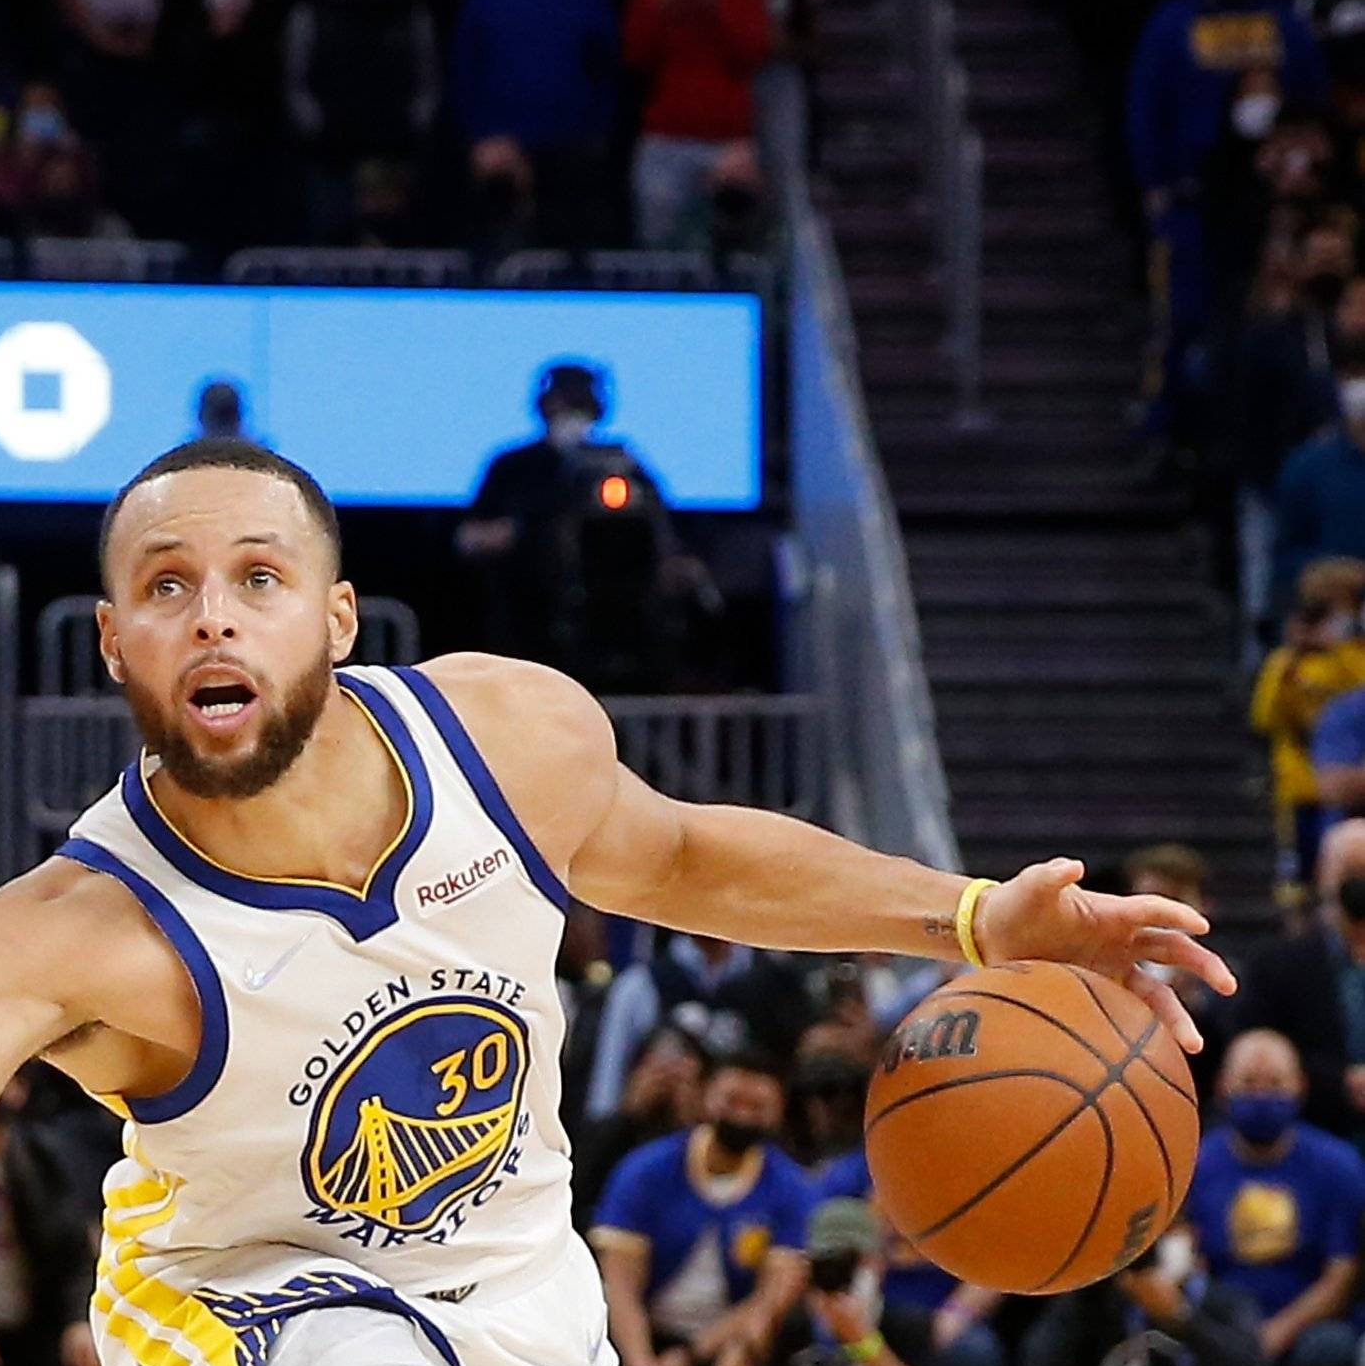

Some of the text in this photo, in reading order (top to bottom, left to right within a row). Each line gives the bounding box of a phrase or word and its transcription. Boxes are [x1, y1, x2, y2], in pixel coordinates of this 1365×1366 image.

[416, 847, 510, 908] Rakuten
[288, 967, 527, 1108] GOLDEN STATE
[430, 1031, 509, 1118] 30
